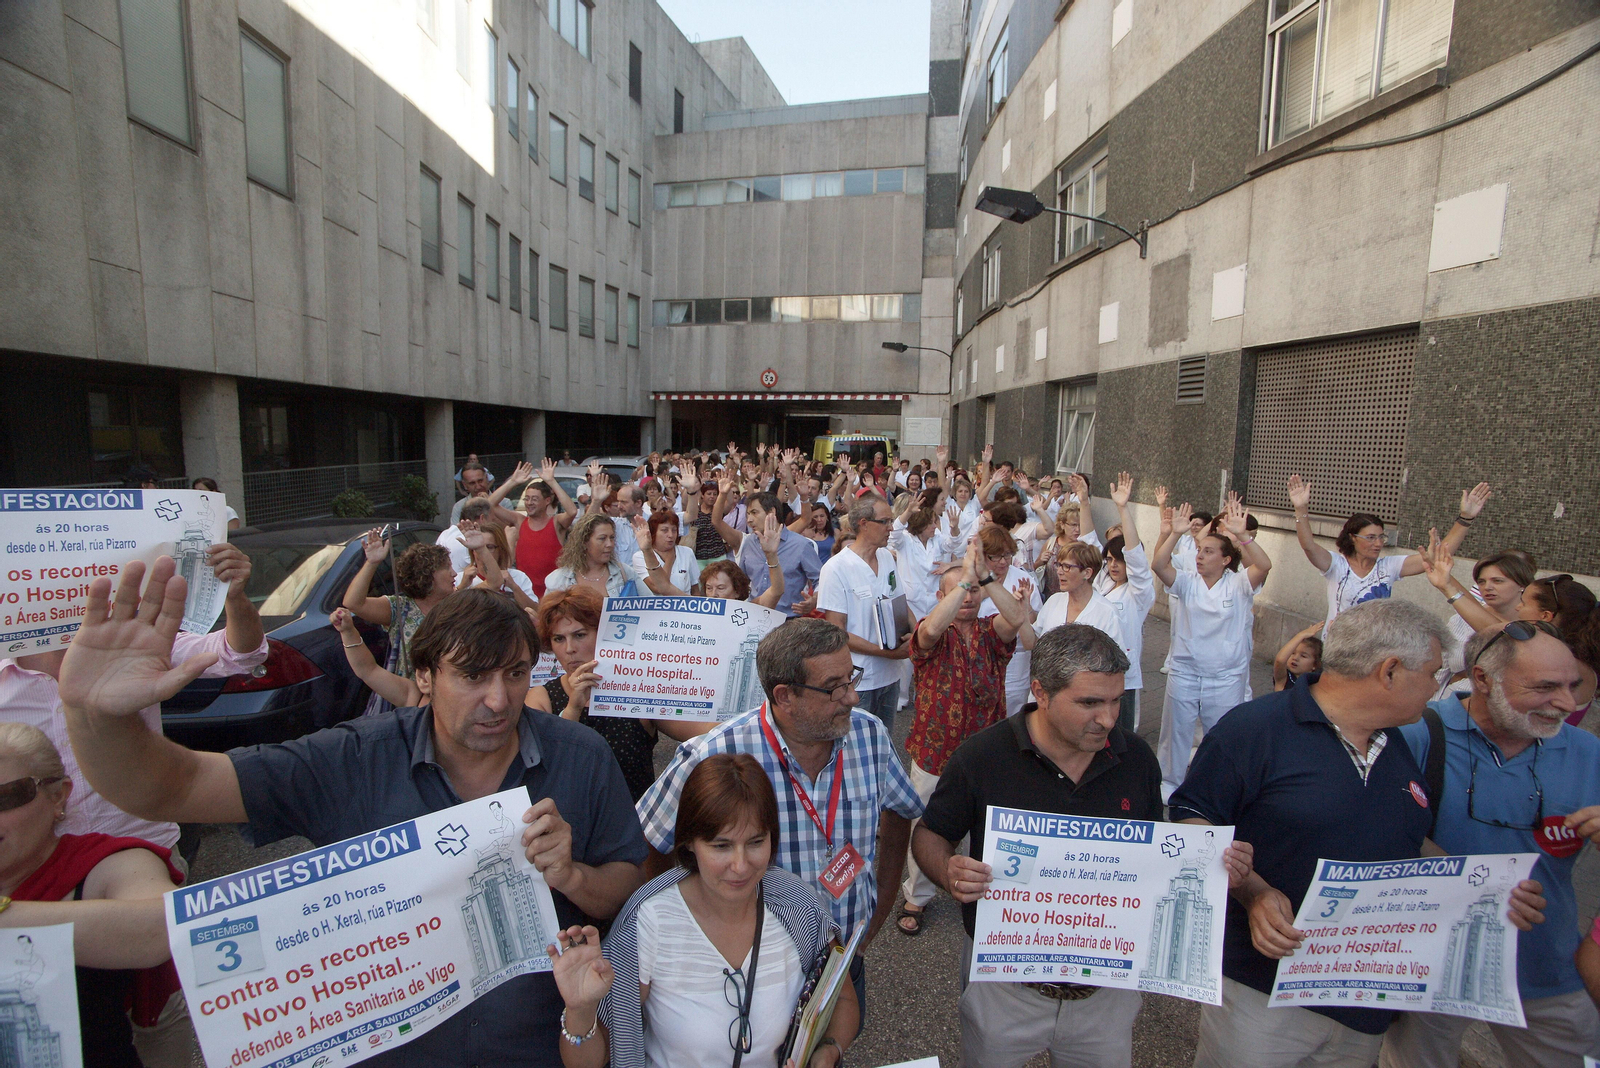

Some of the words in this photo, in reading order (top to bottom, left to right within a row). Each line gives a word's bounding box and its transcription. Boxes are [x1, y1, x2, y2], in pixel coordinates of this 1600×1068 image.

[0, 490, 134, 509] FESTACIÓN
[36, 524, 51, 533] ás
[55, 524, 70, 533] 20
[75, 524, 109, 532] horas
[7, 542, 36, 553] desde
[40, 543, 45, 552] o
[48, 541, 58, 552] H.
[61, 540, 87, 552] Xeral,
[89, 539, 104, 550] rúa
[106, 538, 136, 549] Pizarro
[8, 570, 32, 581] os
[40, 563, 119, 579] recortes
[27, 584, 89, 602] Hospit
[5, 615, 12, 625] a
[17, 607, 46, 624] Área
[50, 605, 86, 620] Sanita
[612, 598, 721, 614] MANIFESTACIÓN
[614, 624, 627, 639] 3
[659, 620, 668, 628] ás
[670, 621, 679, 629] 20
[681, 622, 702, 630] horas
[641, 631, 658, 641] desde
[697, 636, 716, 646] Pizarro
[599, 648, 636, 660] contra
[640, 652, 653, 661] os
[656, 653, 702, 665] recortes
[705, 656, 719, 666] no
[614, 664, 643, 677] Novo
[647, 667, 701, 681] Hospital...
[638, 680, 655, 693] Área
[657, 684, 687, 696] Sanitaria
[689, 686, 697, 695] de
[700, 687, 715, 699] Vigo
[999, 813, 1147, 841] MANIFESTACIÓN
[1000, 842, 1035, 856] SETEMBRO
[1064, 852, 1076, 861] ás
[1078, 853, 1090, 862] 20
[1093, 854, 1120, 864] horas
[832, 852, 850, 873] CCOO
[1003, 856, 1021, 877] 3
[1327, 858, 1460, 880] MANIFESTACIÓN
[185, 829, 410, 918] MANIFESTACIÓN
[836, 862, 855, 887] contigo
[1040, 867, 1061, 878] desde
[1063, 871, 1068, 879] o
[1069, 869, 1077, 879] H.
[1078, 869, 1098, 882] Xeral,
[1100, 870, 1111, 881] rúa
[1113, 871, 1137, 882] Pizarro
[302, 903, 320, 916] ás
[324, 896, 342, 909] 20
[345, 883, 386, 902] horas
[984, 887, 1030, 902] contra
[1035, 891, 1053, 903] os
[1057, 893, 1118, 907] recortes
[1122, 897, 1141, 909] no
[1323, 889, 1354, 898] SETEMBRO
[1378, 889, 1388, 897] ás
[1390, 889, 1401, 897] 20
[1402, 887, 1428, 896] horas
[1321, 900, 1339, 918] 3
[1352, 905, 1371, 914] desde
[1417, 901, 1440, 912] Pizarro
[275, 930, 310, 952] desde
[312, 927, 320, 938] o
[321, 920, 335, 935] H.
[336, 909, 367, 929] Xeral,
[367, 904, 385, 921] rúa
[386, 894, 423, 915] Pizarro
[1002, 908, 1040, 923] Novo
[1044, 910, 1117, 929] Hospital...
[197, 921, 254, 942] SETEMBRO
[1342, 925, 1358, 936] os
[1361, 922, 1416, 935] recortes
[1419, 923, 1437, 933] no
[979, 931, 1022, 945] ...defende
[1025, 937, 1030, 945] a
[1033, 928, 1054, 946] Área
[1057, 933, 1097, 949] Sanitaria
[1100, 936, 1111, 951] de
[1114, 937, 1135, 955] Vigo
[1306, 943, 1341, 955] Novo
[1345, 939, 1412, 956] Hospital...
[215, 940, 242, 972] 3
[1069, 956, 1105, 966] SANITARIA
[1107, 960, 1124, 968] VIGO
[200, 976, 279, 1016] contra
[286, 964, 314, 984] os
[320, 931, 410, 971] recortes
[416, 916, 442, 939] no
[1332, 957, 1352, 973] Área
[1354, 960, 1393, 975] Sanitaria
[1395, 962, 1407, 975] de
[1410, 962, 1429, 979] Vigo
[473, 973, 505, 993] HOSPITAL
[505, 963, 526, 974] XERAL
[1365, 981, 1400, 990] SANITARIA
[242, 996, 307, 1031] Novo
[312, 957, 422, 1003] Hospital...
[1139, 980, 1165, 988] HOSPITAL
[1167, 983, 1185, 991] XERAL
[1187, 987, 1216, 998] 1955-2015
[296, 1025, 307, 1039] a
[310, 1011, 343, 1034] Área
[345, 987, 406, 1018] Sanitaria
[409, 979, 425, 996] de
[426, 962, 455, 985] Vigo
[295, 1036, 344, 1062] PERSOAL
[346, 1025, 375, 1041] ÁREA
[375, 1003, 426, 1028] SANITARIA
[427, 989, 449, 1006] VIGO
[341, 1043, 358, 1057] SAE
